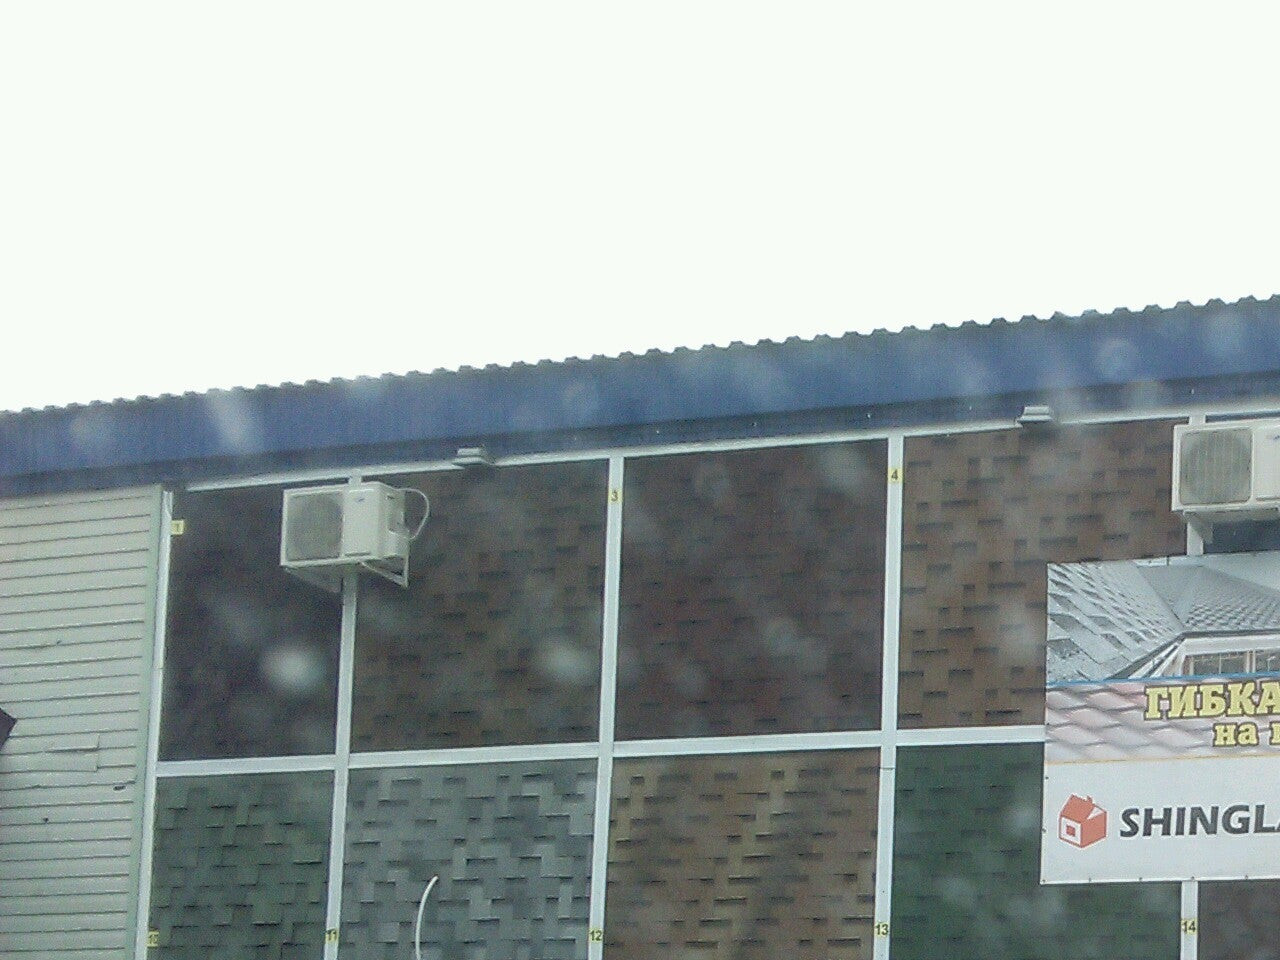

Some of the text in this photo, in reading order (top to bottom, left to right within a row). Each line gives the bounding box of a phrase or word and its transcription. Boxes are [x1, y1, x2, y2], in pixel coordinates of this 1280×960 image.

[891, 469, 899, 482] 4
[611, 490, 619, 503] 3
[1213, 720, 1259, 747] на
[876, 924, 889, 936] 13
[1181, 921, 1196, 933] 14
[590, 930, 602, 942] 12
